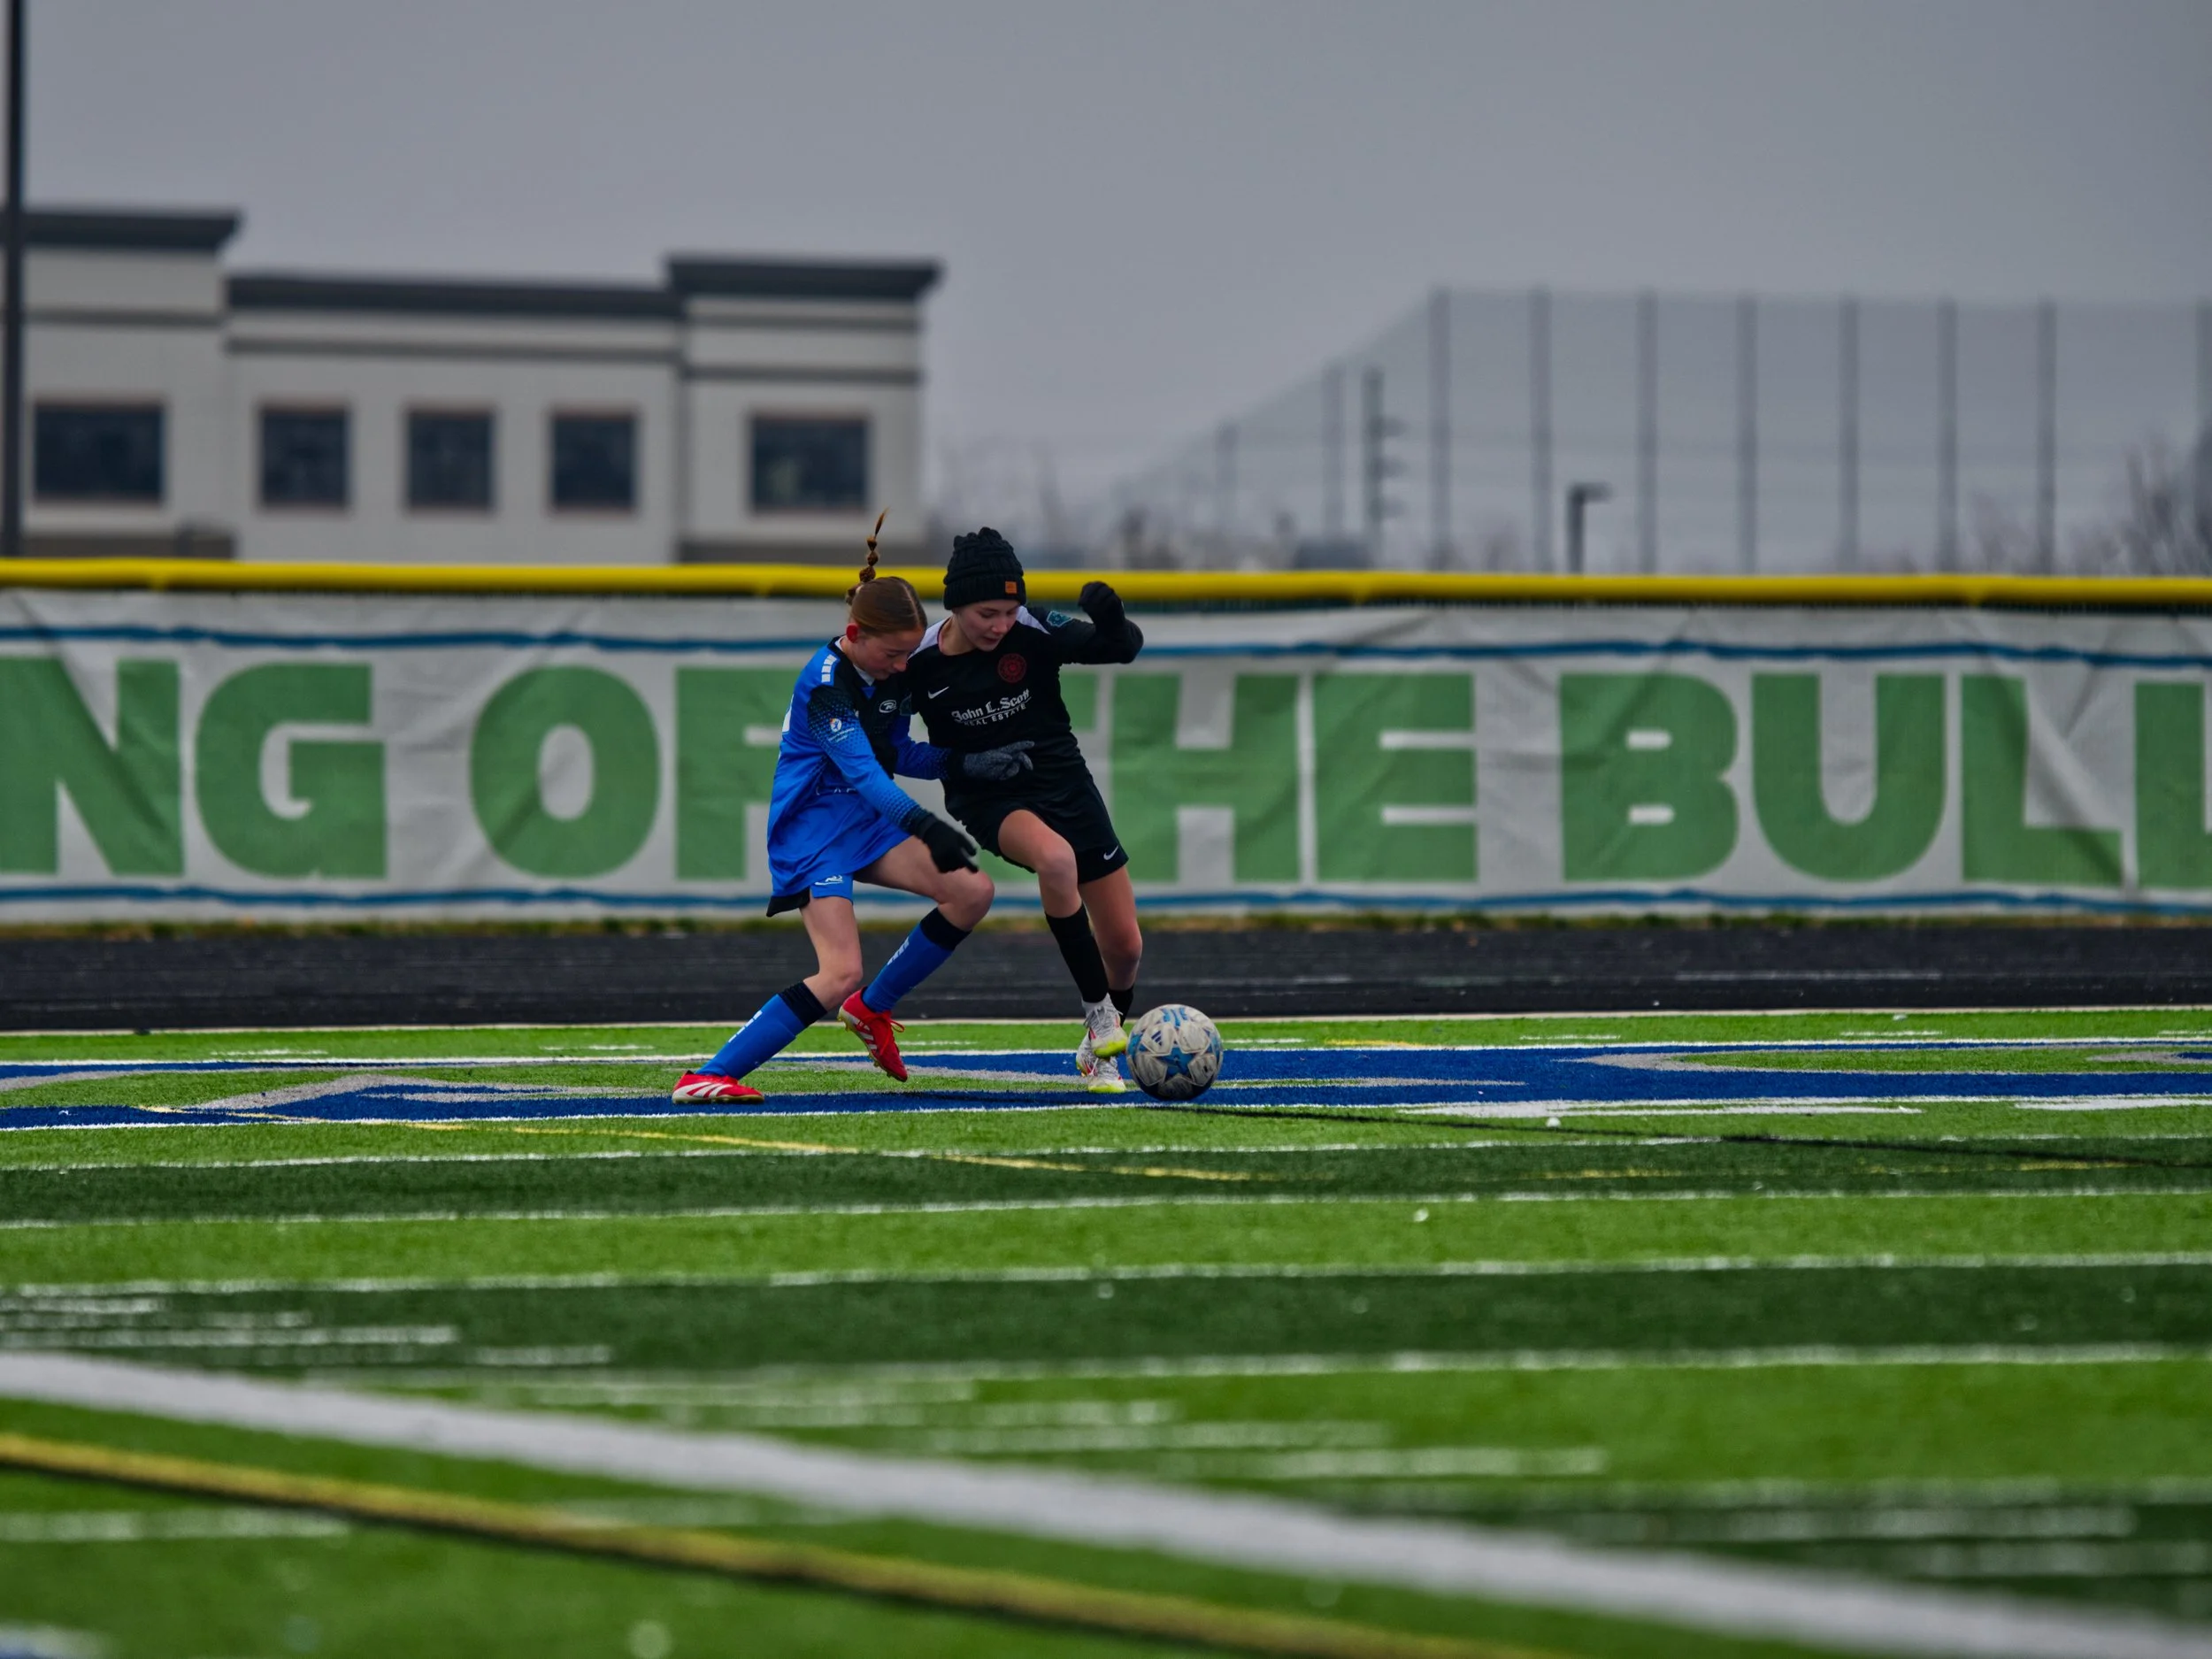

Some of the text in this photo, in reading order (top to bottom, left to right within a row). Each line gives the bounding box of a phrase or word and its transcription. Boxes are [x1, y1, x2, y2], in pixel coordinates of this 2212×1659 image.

[951, 707, 984, 723] John
[999, 688, 1030, 710] Scott
[991, 703, 1027, 722] ESTATE
[0, 656, 387, 879] NG
[471, 664, 796, 880] OF
[979, 668, 1479, 884] HE
